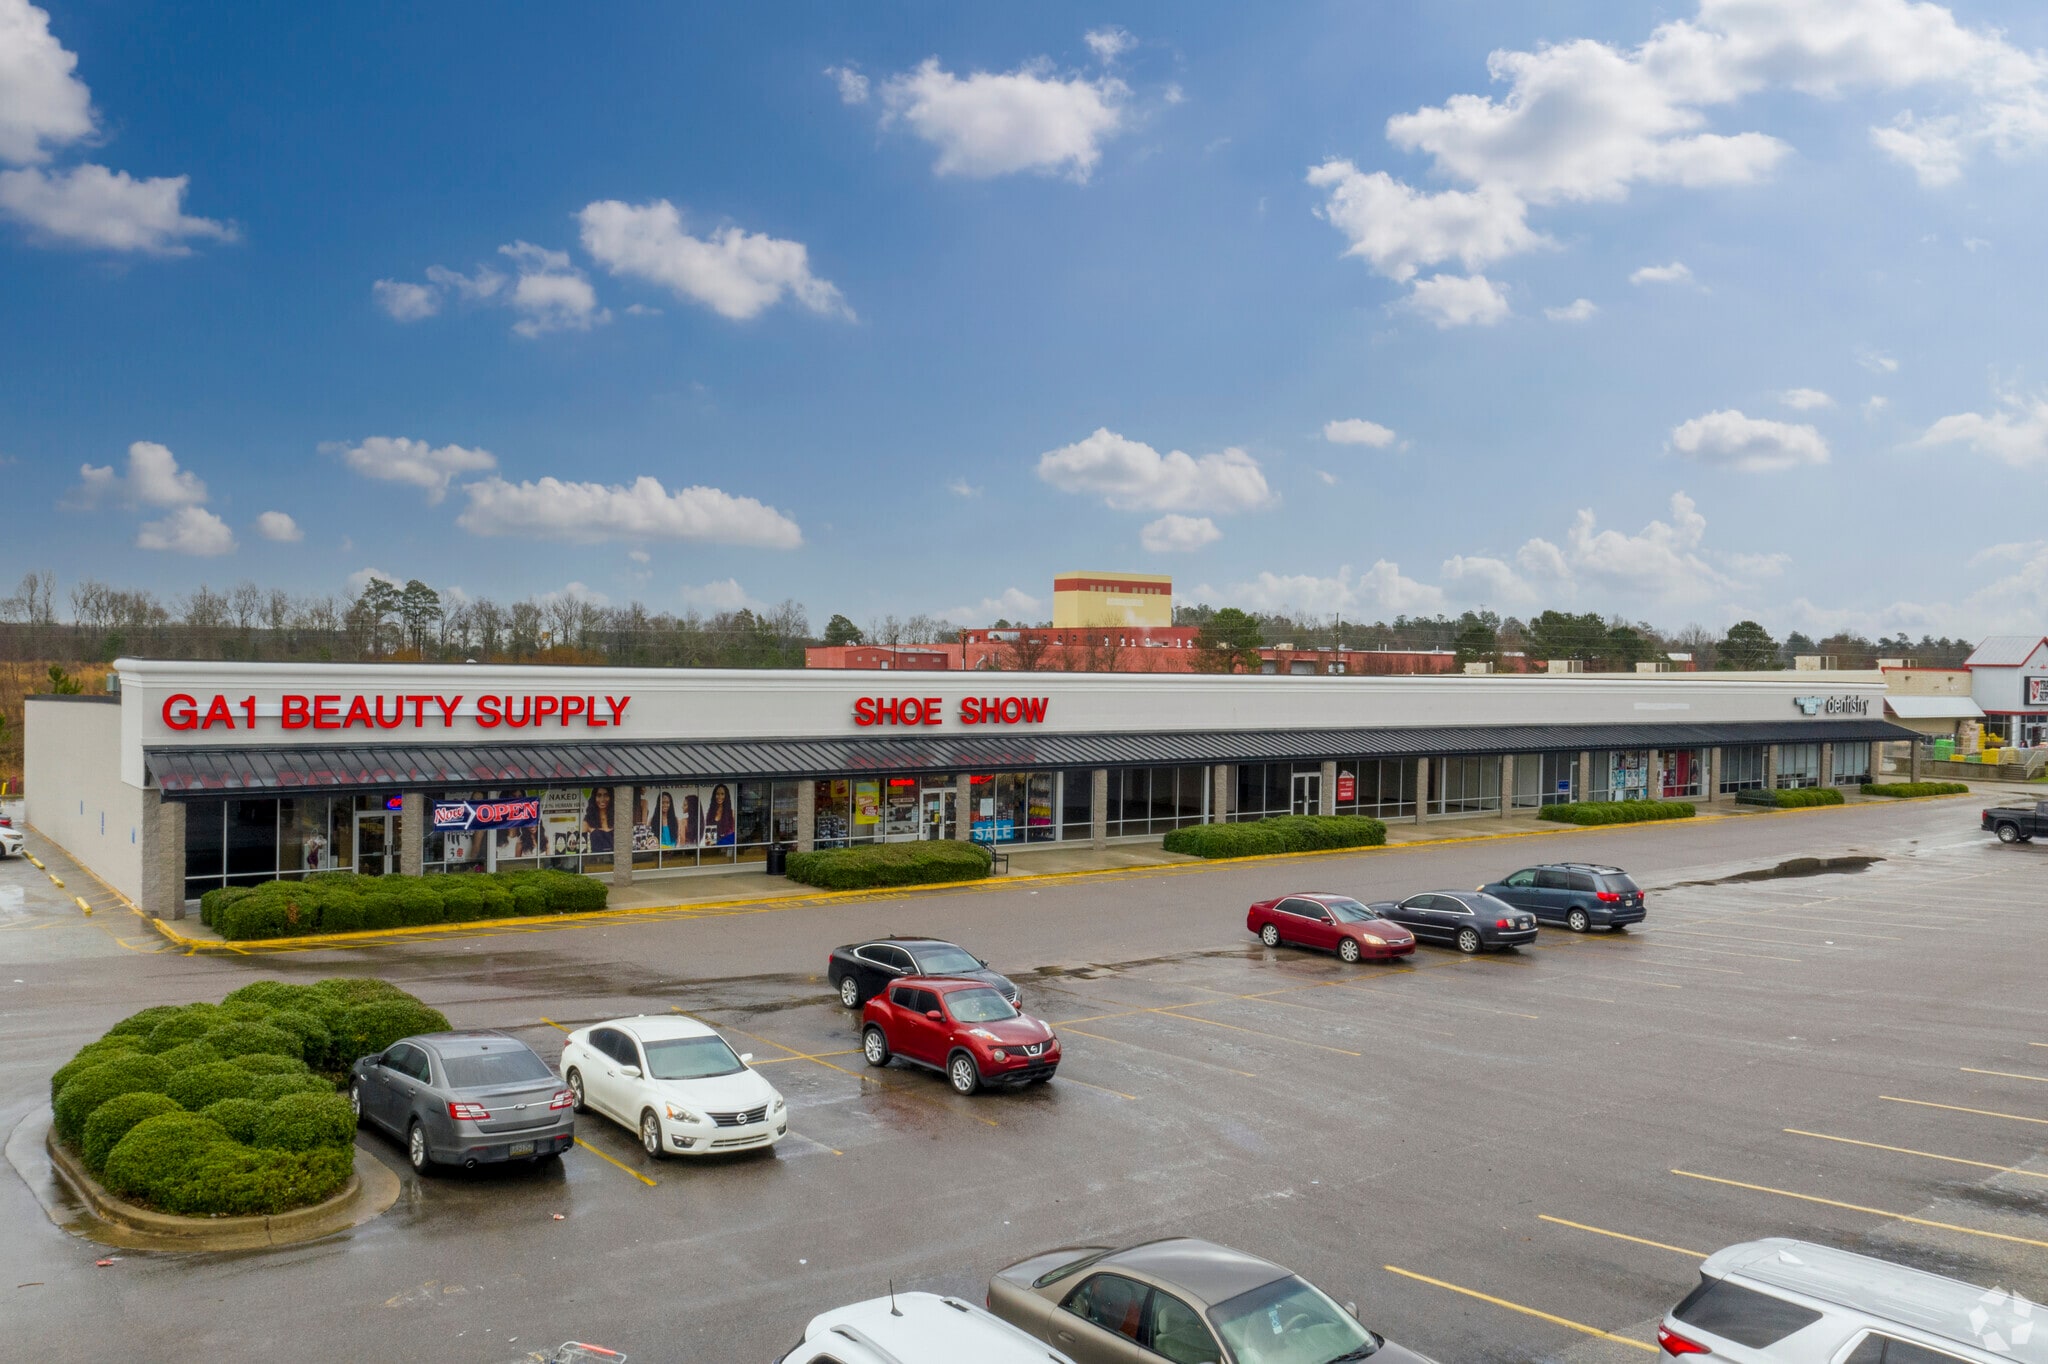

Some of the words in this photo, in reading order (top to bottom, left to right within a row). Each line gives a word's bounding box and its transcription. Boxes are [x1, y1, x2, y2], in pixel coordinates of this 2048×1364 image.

[162, 693, 256, 731] GA1
[281, 694, 464, 730] BEAUTY
[475, 694, 632, 728] SUPPLY
[855, 697, 942, 726] SHOE
[961, 697, 1049, 725] SHOW
[1826, 695, 1869, 715] dentistry
[548, 793, 577, 801] NAKED
[434, 806, 465, 824] Now
[476, 800, 539, 823] OPEN
[975, 825, 1012, 841] SALE
